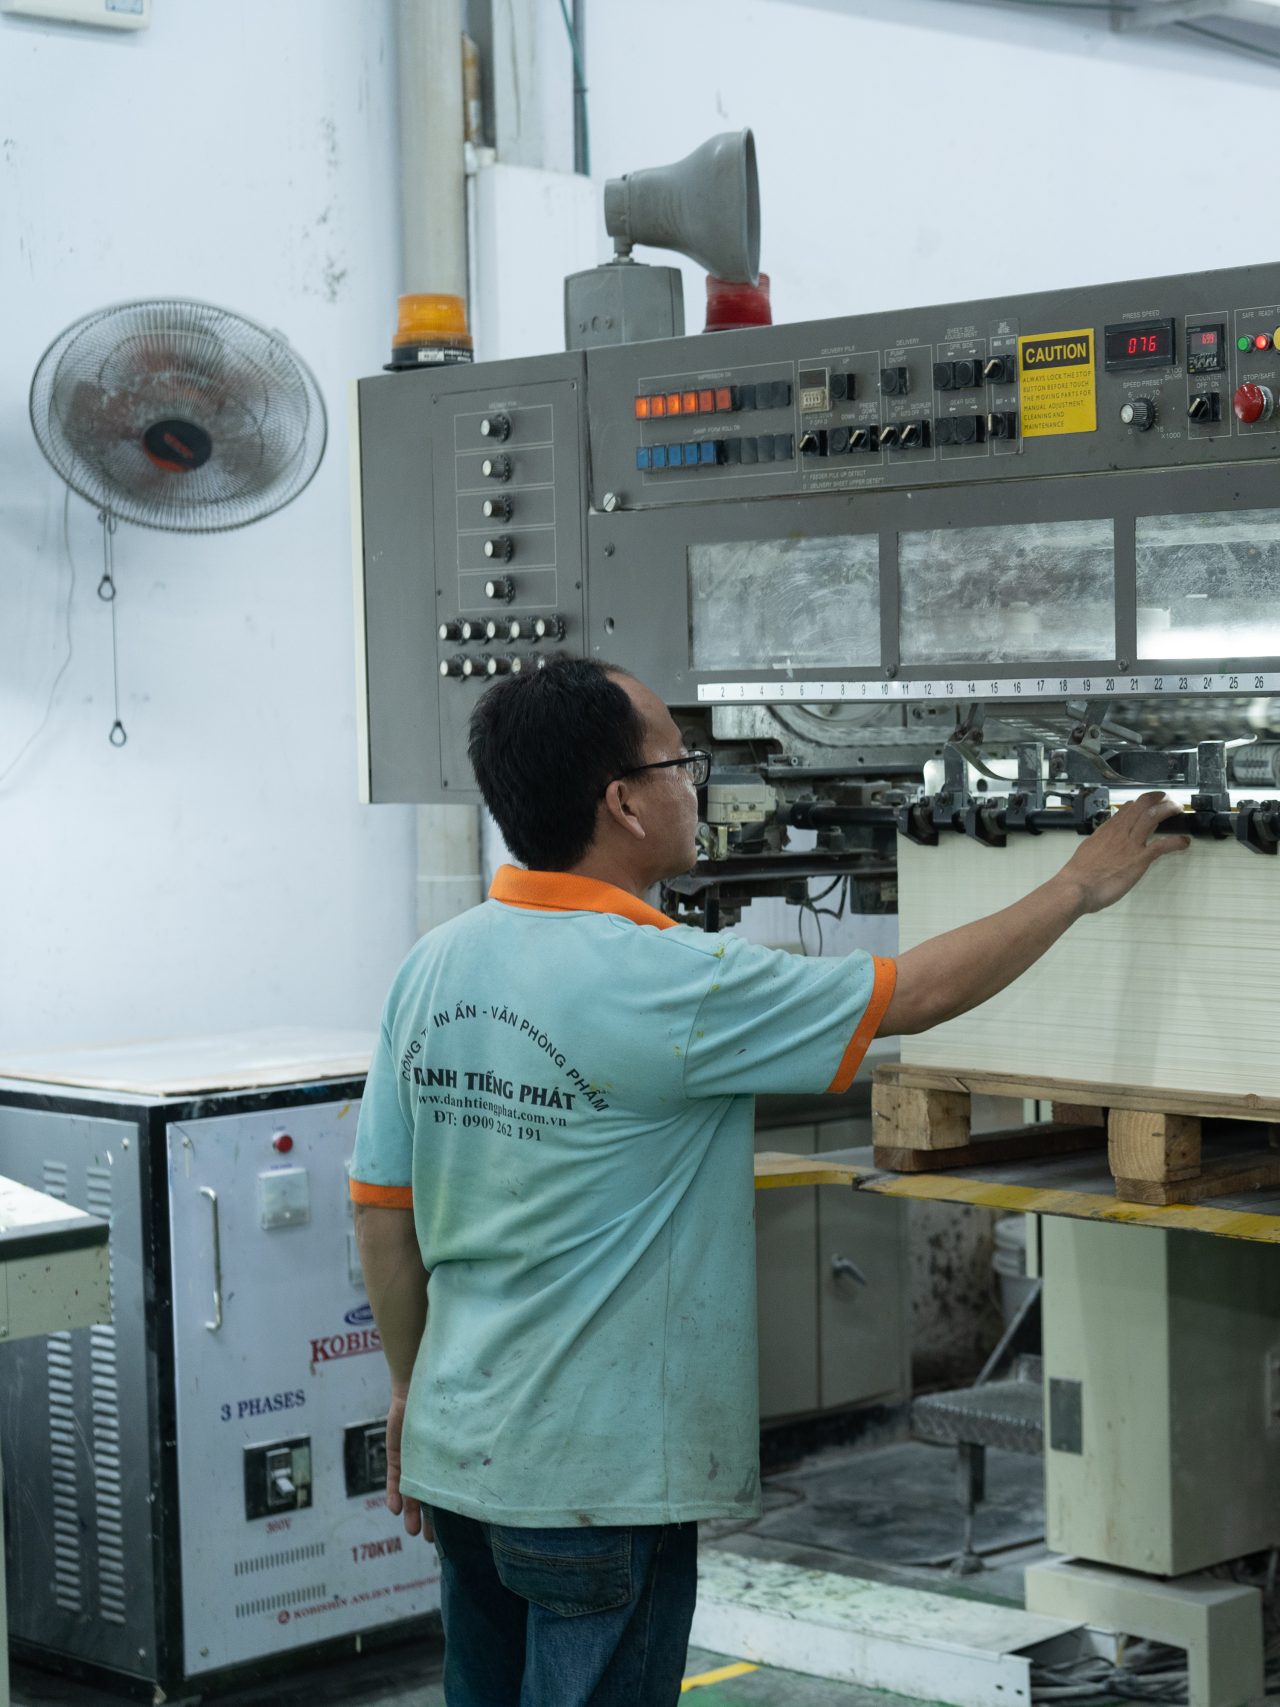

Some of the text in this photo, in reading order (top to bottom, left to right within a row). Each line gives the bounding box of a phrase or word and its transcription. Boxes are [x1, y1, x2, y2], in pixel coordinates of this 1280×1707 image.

[1122, 310, 1160, 320] PRESS SPEED
[896, 338, 920, 346] DELIVERY
[1127, 335, 1157, 354] 076
[1025, 342, 1087, 364] CAUTION
[1023, 375, 1046, 383] ALWAYS
[1047, 373, 1062, 381] LOCK
[1196, 374, 1222, 382] COUNTER
[1242, 372, 1276, 381] STOP/SAFE
[1023, 381, 1089, 393] BUTTON BEFORE TOUCH
[1122, 379, 1164, 389] SPEED PRESET
[1036, 393, 1060, 401] MOVING
[1024, 404, 1046, 412] MANUAL
[1024, 413, 1052, 421] CLEANING
[1024, 421, 1064, 430] MAINTENANCE
[882, 684, 888, 695] 10
[902, 684, 909, 695] 11
[924, 684, 932, 695] 12
[946, 683, 954, 694] 13
[968, 682, 976, 694] 14
[990, 682, 998, 694] 15
[1014, 682, 1022, 694] 16
[1038, 680, 1044, 691] 17
[1060, 680, 1068, 692] 18
[1082, 680, 1090, 692] 19
[1106, 678, 1114, 691] 20
[1130, 678, 1138, 691] 21
[1154, 678, 1163, 690] 22
[1179, 678, 1188, 690] 23
[1204, 677, 1212, 690] 24
[1230, 676, 1239, 690] 25
[1255, 676, 1264, 690] 26
[402, 1041, 422, 1082] CÔNG
[433, 1010, 450, 1028] IN
[455, 1000, 477, 1020] ẤN
[491, 1006, 519, 1027] VĂN
[520, 1019, 566, 1069] PHÒNG
[464, 1070, 514, 1100] TIẾNG
[519, 1086, 576, 1110] PHÁT
[433, 1110, 542, 1142] ĐT: 0909 262 191
[309, 1329, 382, 1363] KOBIS
[220, 1389, 306, 1422] 3 PHASES
[352, 1536, 403, 1564] 170KVA
